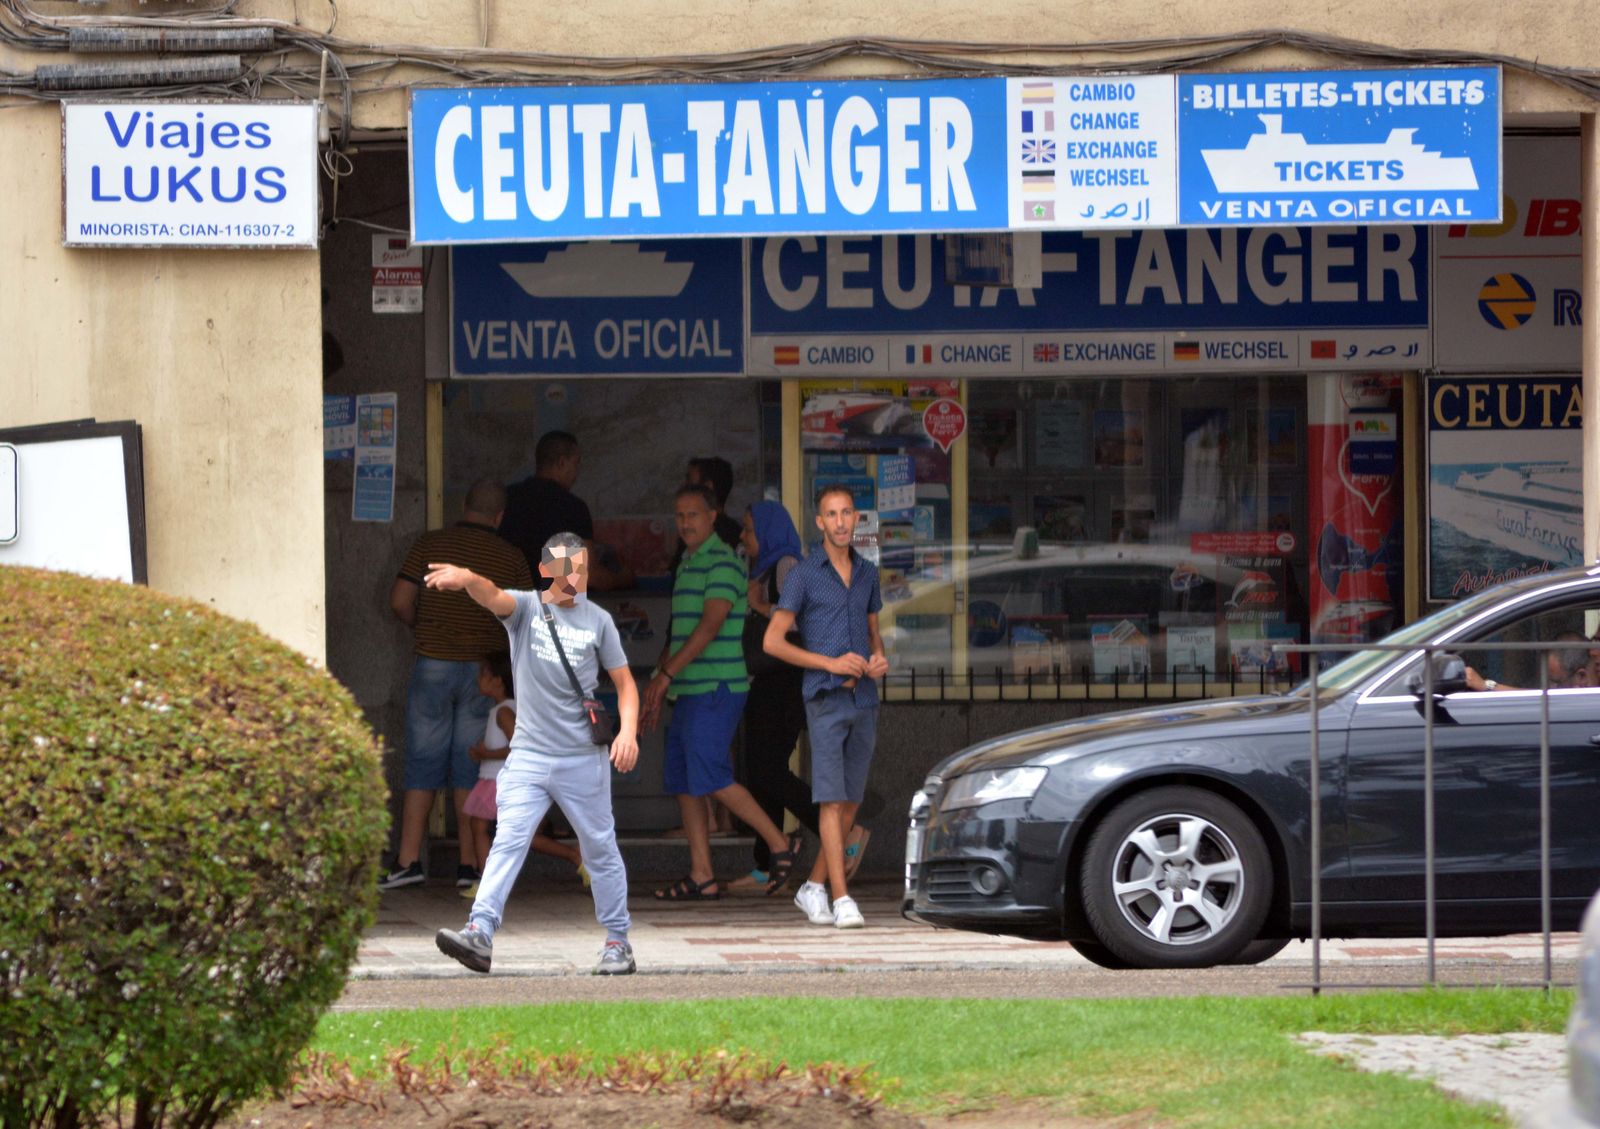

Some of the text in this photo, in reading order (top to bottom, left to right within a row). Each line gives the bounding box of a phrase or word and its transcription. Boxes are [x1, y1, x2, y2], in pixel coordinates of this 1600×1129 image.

[1069, 83, 1136, 101] CAMBIO
[1193, 79, 1485, 109] BILLETES-TICKETS
[1069, 112, 1140, 130] CHANGE
[104, 111, 272, 158] Viajes
[434, 95, 978, 223] CEUTA-TANGER
[1066, 140, 1158, 160] EXCHANGE
[1069, 168, 1150, 187] WECHSEL
[1274, 160, 1405, 182] TICKETS
[91, 165, 288, 203] LUKUS
[1199, 198, 1472, 219] VENTA OFICIAL
[1524, 199, 1582, 238] IB
[79, 222, 295, 238] MINORISTA: CIAN-116307-2
[375, 269, 422, 281] Alarma
[762, 225, 1418, 312] CEU-TANGER
[462, 318, 733, 360] VENTA OFICIAL
[807, 346, 875, 365] CAMBIO
[940, 345, 1011, 363] CHANGE
[1063, 343, 1156, 362] EXCHANGE
[1205, 341, 1289, 359] WECHSEL
[1433, 384, 1583, 428] CEUTA
